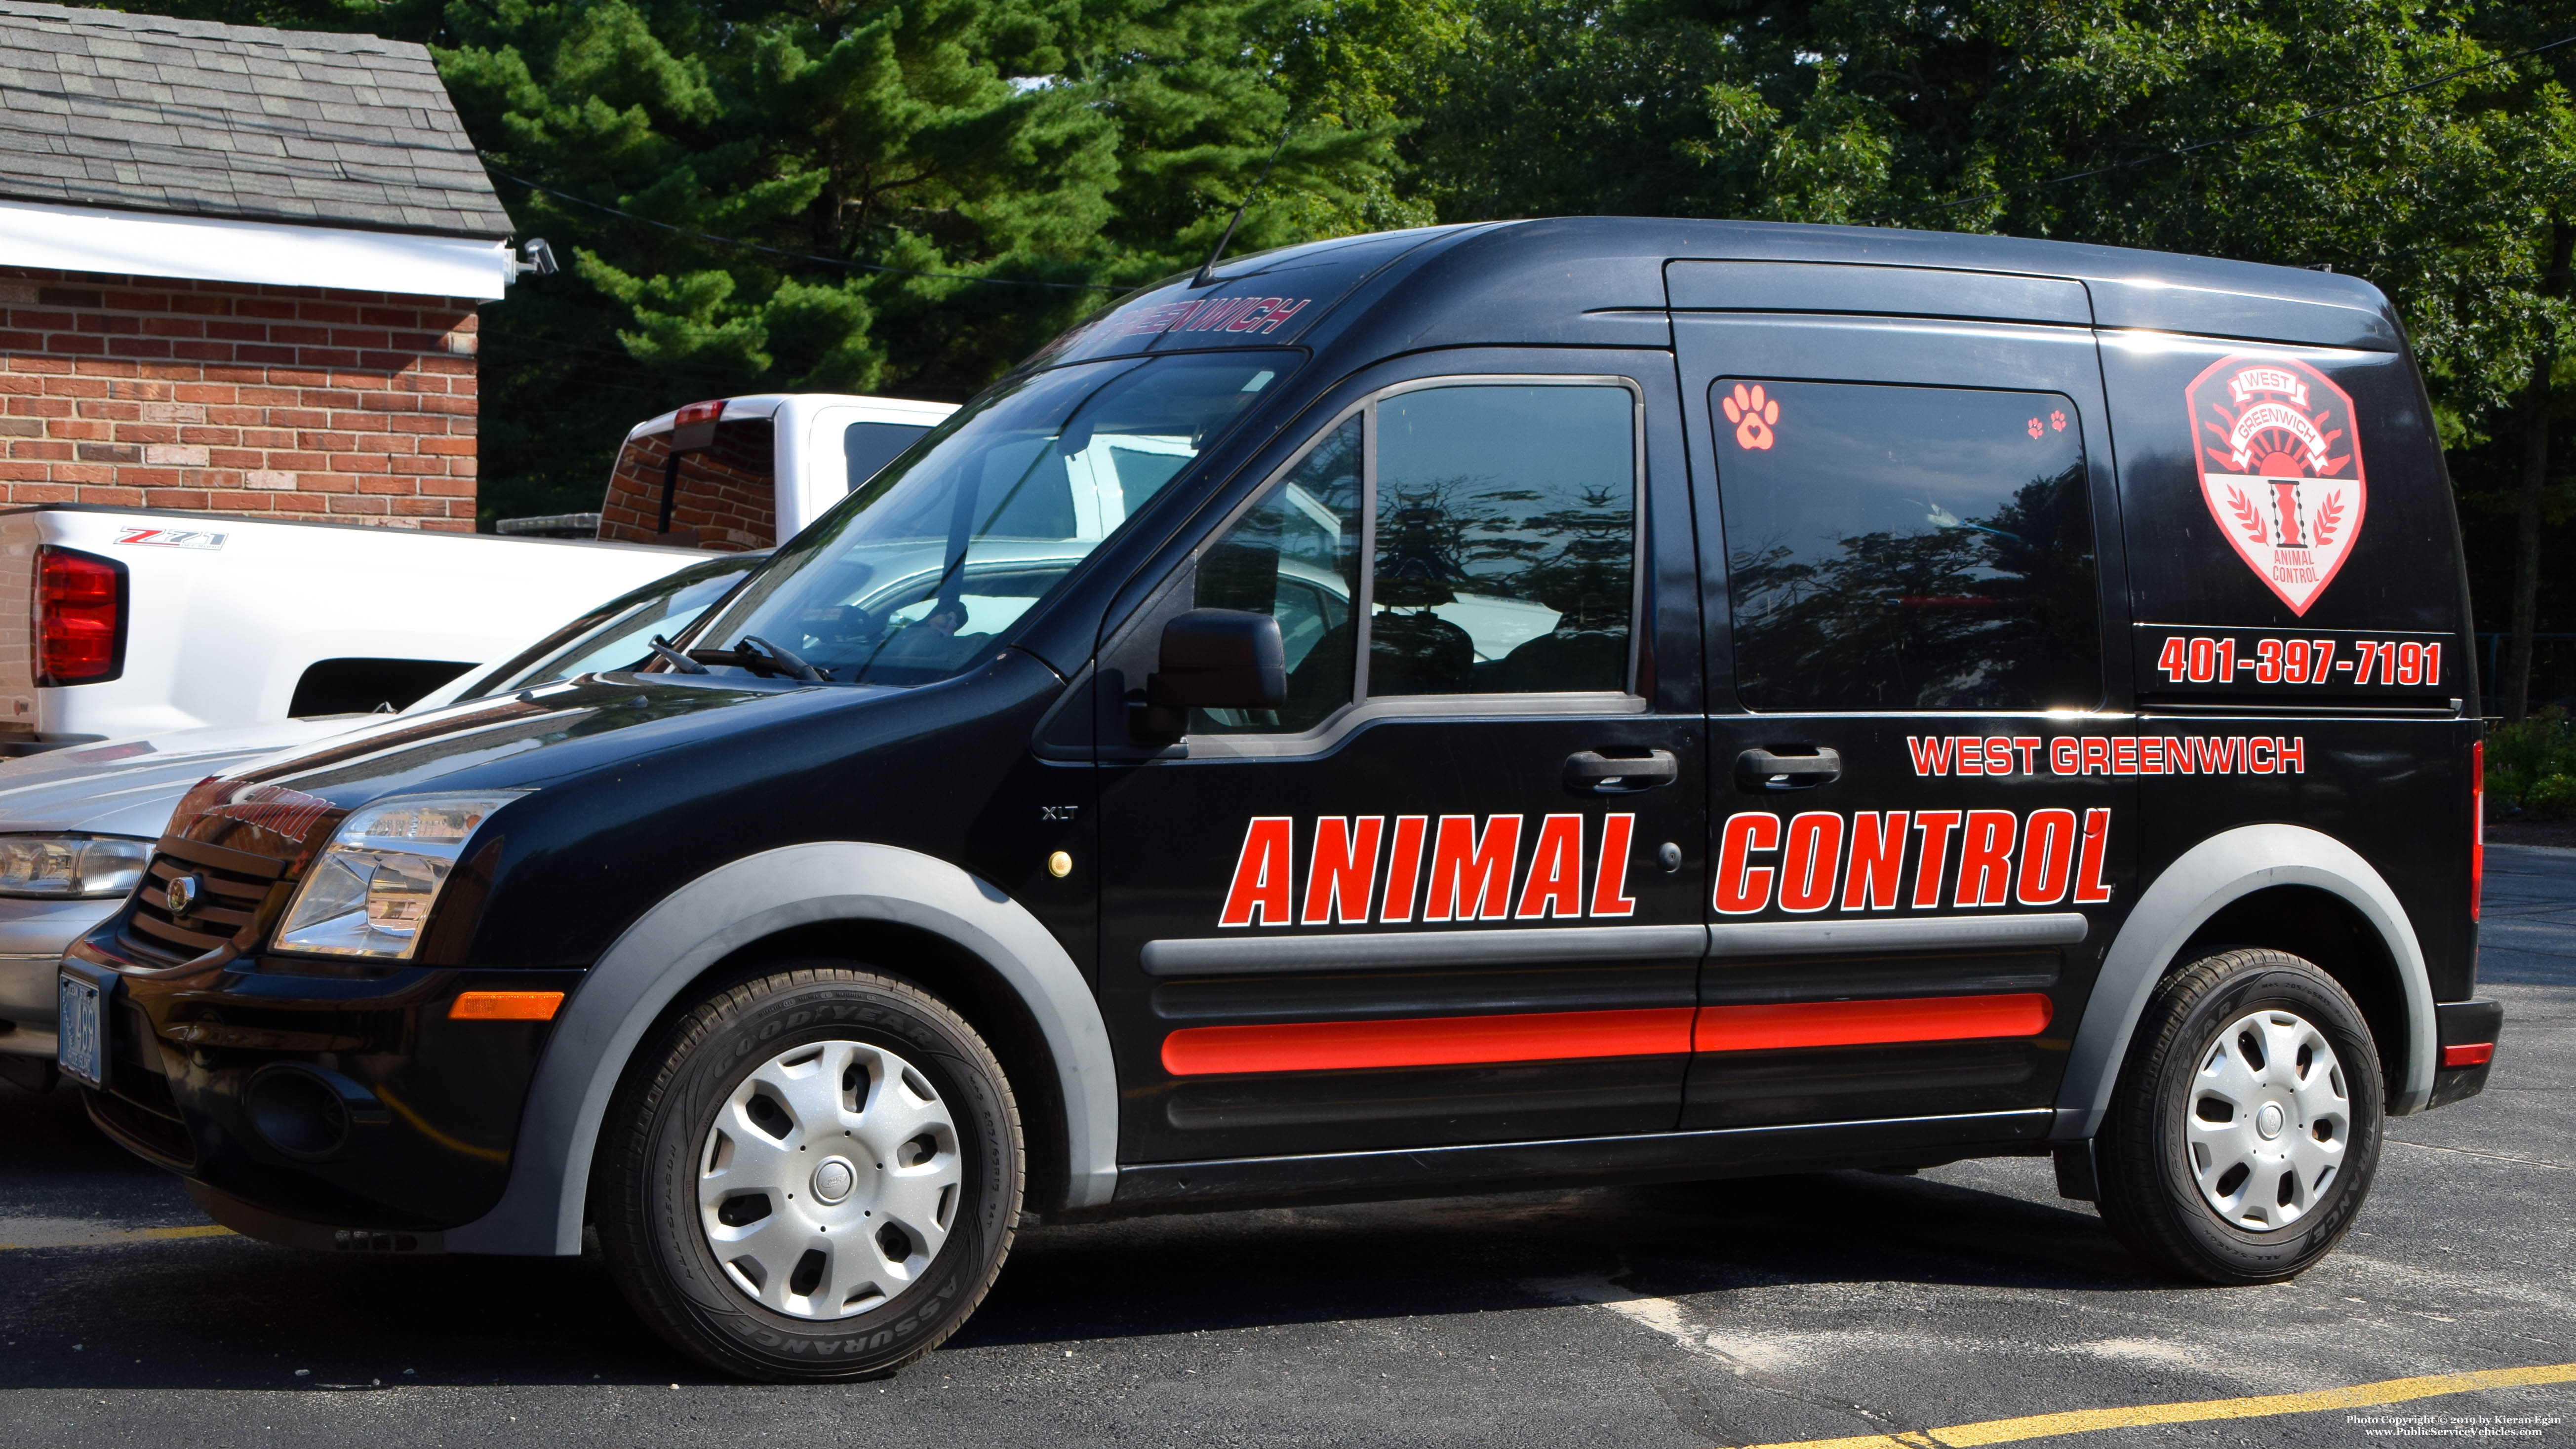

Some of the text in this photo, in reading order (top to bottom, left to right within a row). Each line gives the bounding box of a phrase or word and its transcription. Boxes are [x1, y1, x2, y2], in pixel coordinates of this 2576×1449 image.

[2244, 372, 2290, 389] WEST
[2238, 408, 2316, 443] GREENWICH
[114, 527, 228, 547] Z71
[2273, 565, 2319, 583] CONTROL
[2274, 549, 2314, 565] ANIMAL
[2157, 637, 2441, 686] 401-397-7191
[1907, 736, 2305, 776] WEST GREENWICH
[1042, 806, 1078, 820] XLT
[1218, 808, 2112, 928] ANIMAL CONTROL
[77, 1003, 96, 1055] 489
[2313, 1061, 2374, 1243] ASSURANCE
[665, 1144, 694, 1280] ALL-SEASON
[2204, 1229, 2281, 1260] ALL-SEASON
[728, 1275, 958, 1355] ASSURANCE
